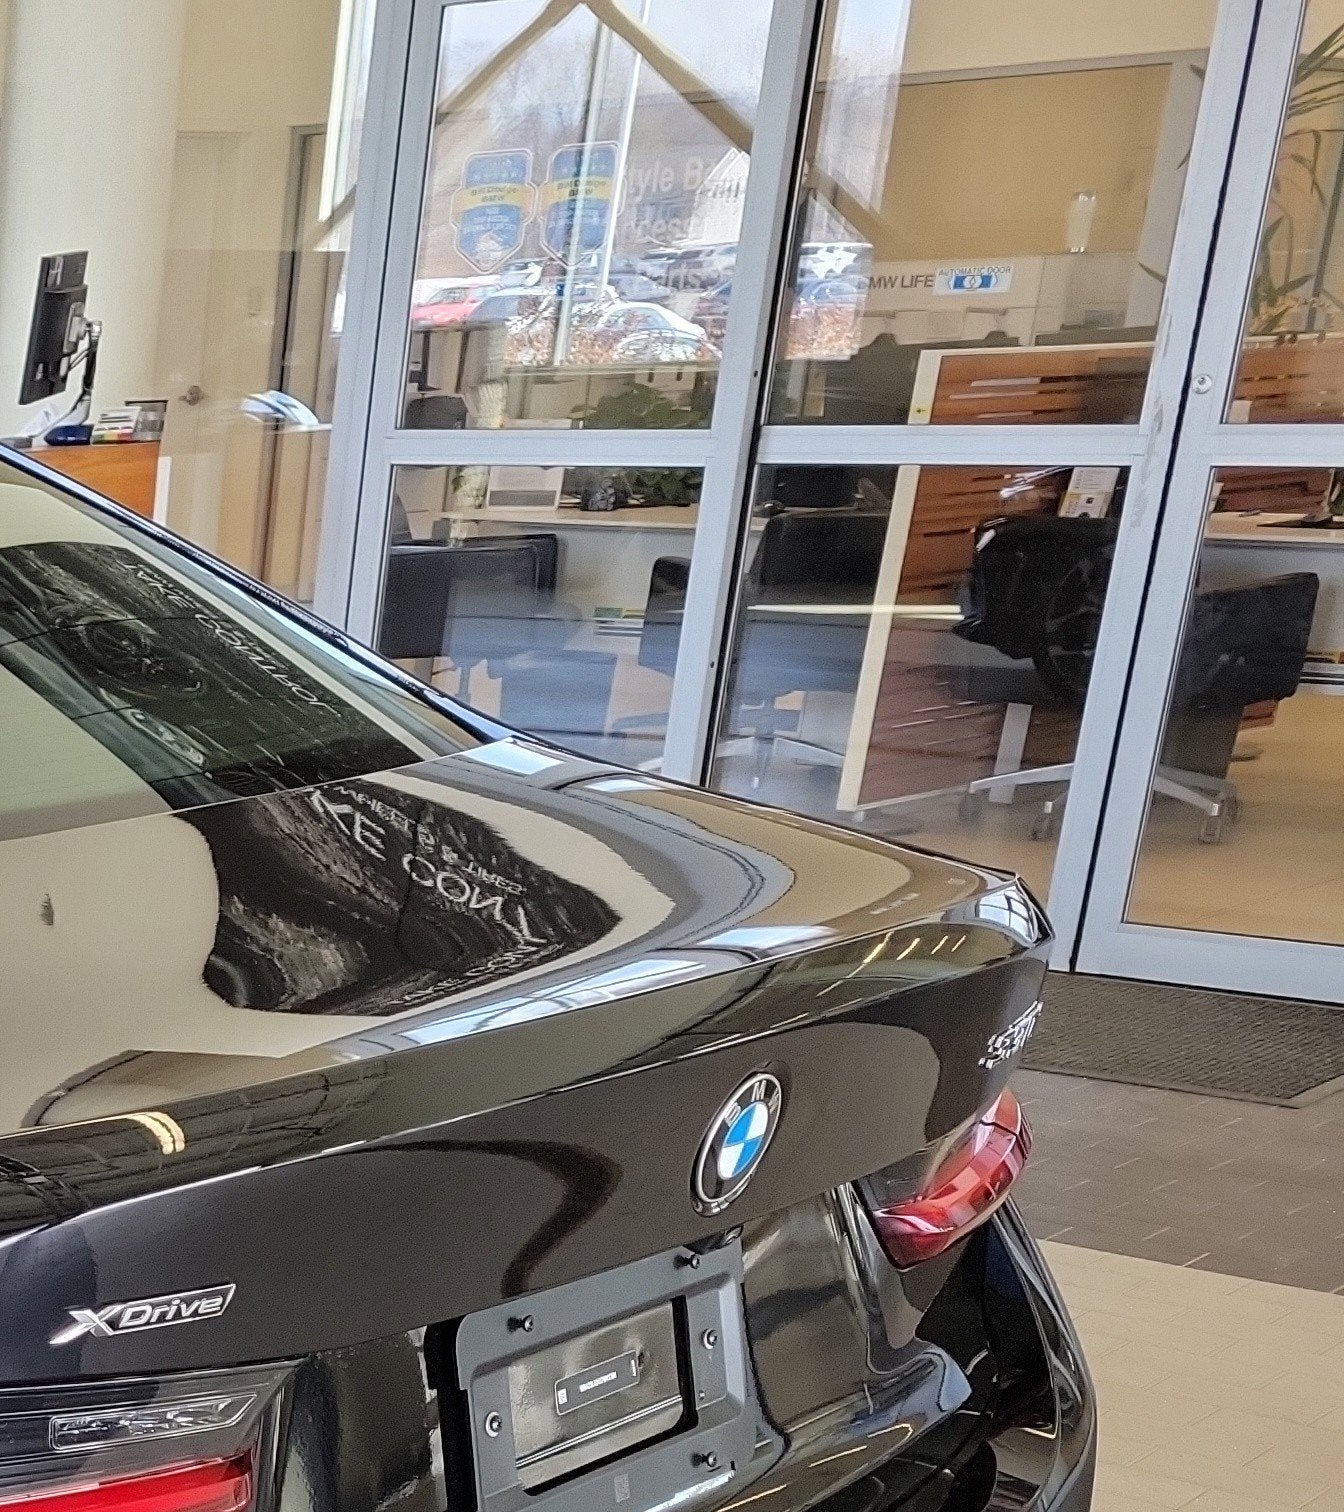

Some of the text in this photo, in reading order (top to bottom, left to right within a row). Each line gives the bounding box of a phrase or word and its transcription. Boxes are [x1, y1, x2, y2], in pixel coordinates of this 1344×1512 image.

[939, 266, 1012, 275] AUTOMATIC DOOR
[900, 275, 934, 288] LIFE
